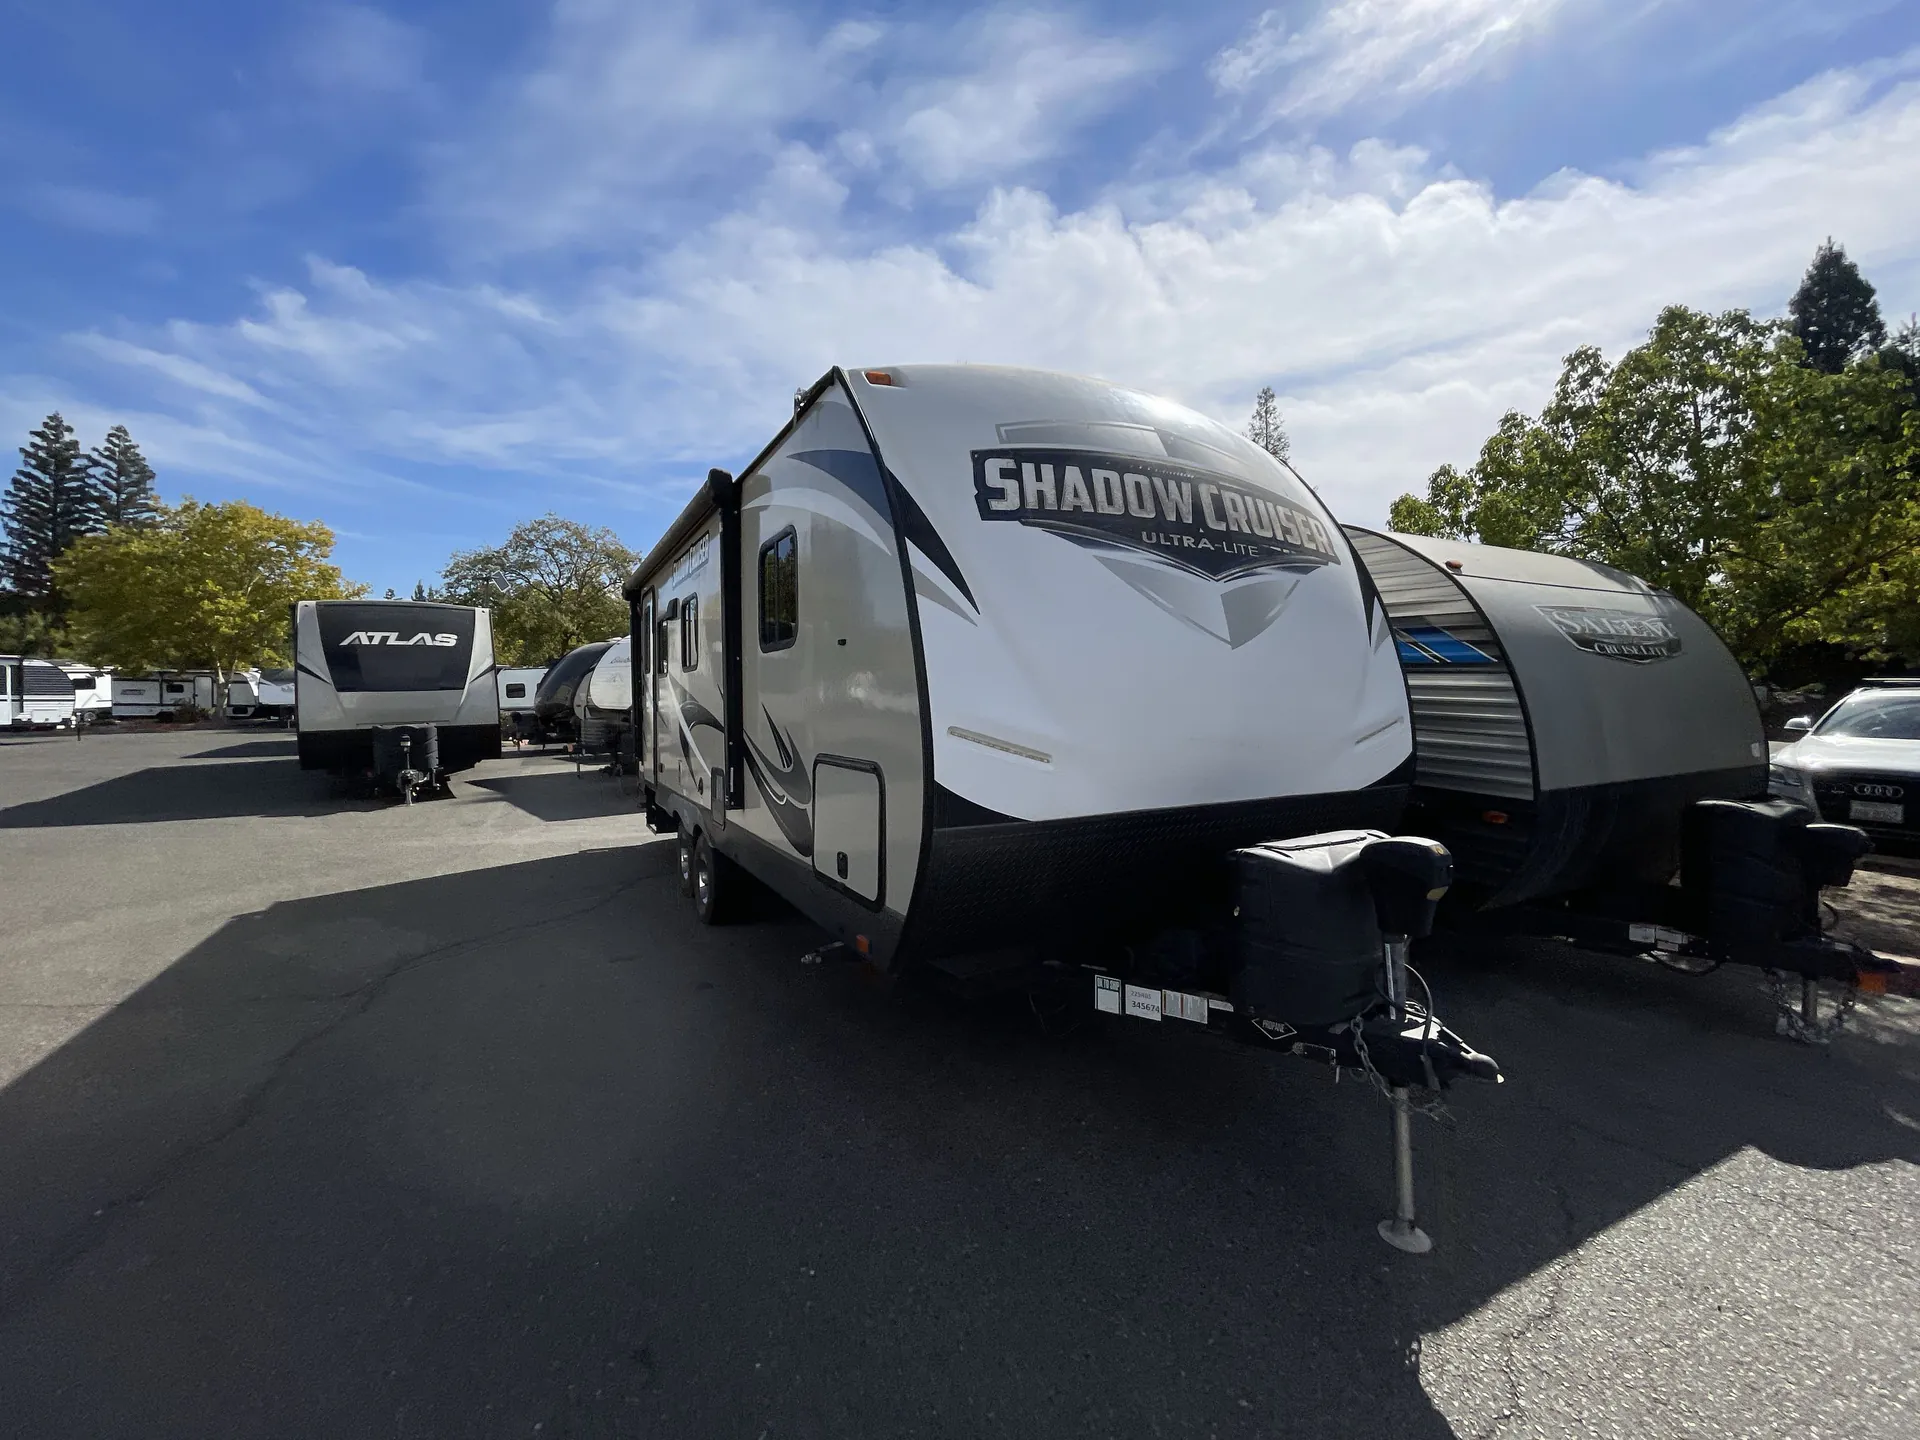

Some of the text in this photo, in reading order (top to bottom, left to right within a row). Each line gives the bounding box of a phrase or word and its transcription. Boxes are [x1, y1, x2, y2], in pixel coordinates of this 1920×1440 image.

[984, 457, 1336, 556] SHADOW CRUISER
[1141, 530, 1260, 558] ULTRA-LITE
[1551, 610, 1678, 639] SALEM
[338, 631, 459, 647] ATLAS
[1131, 1000, 1160, 1014] 345674
[1262, 1019, 1285, 1033] PROPANE
